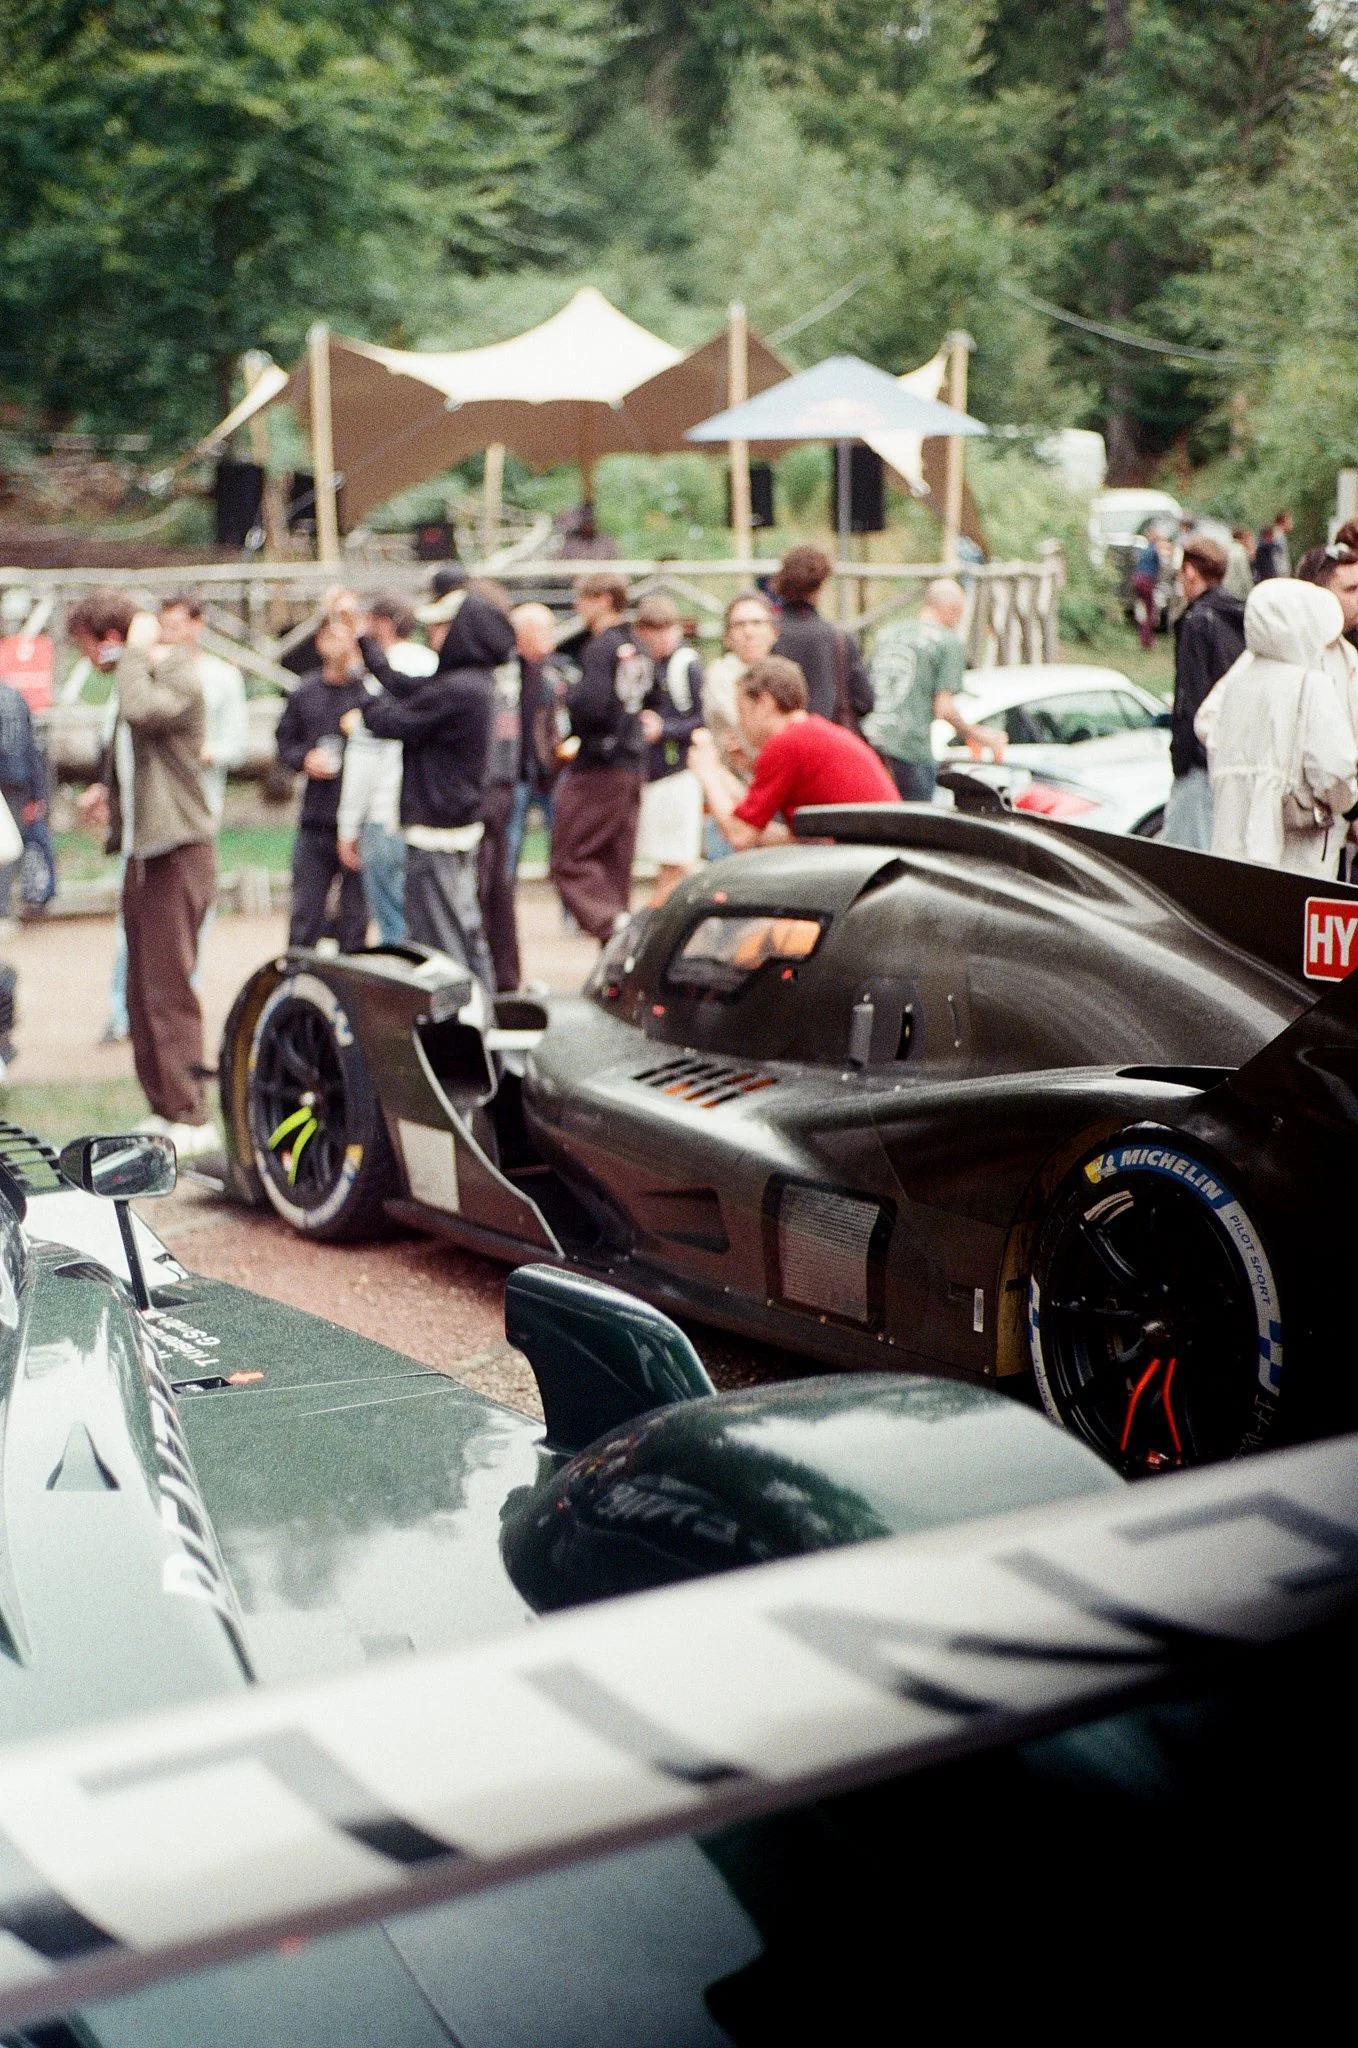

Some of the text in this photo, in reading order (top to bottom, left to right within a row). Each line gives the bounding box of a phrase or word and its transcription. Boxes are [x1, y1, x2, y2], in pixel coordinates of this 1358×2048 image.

[1120, 1149, 1224, 1201] MICHELIN
[1229, 1214, 1271, 1306] PILOT SPORT
